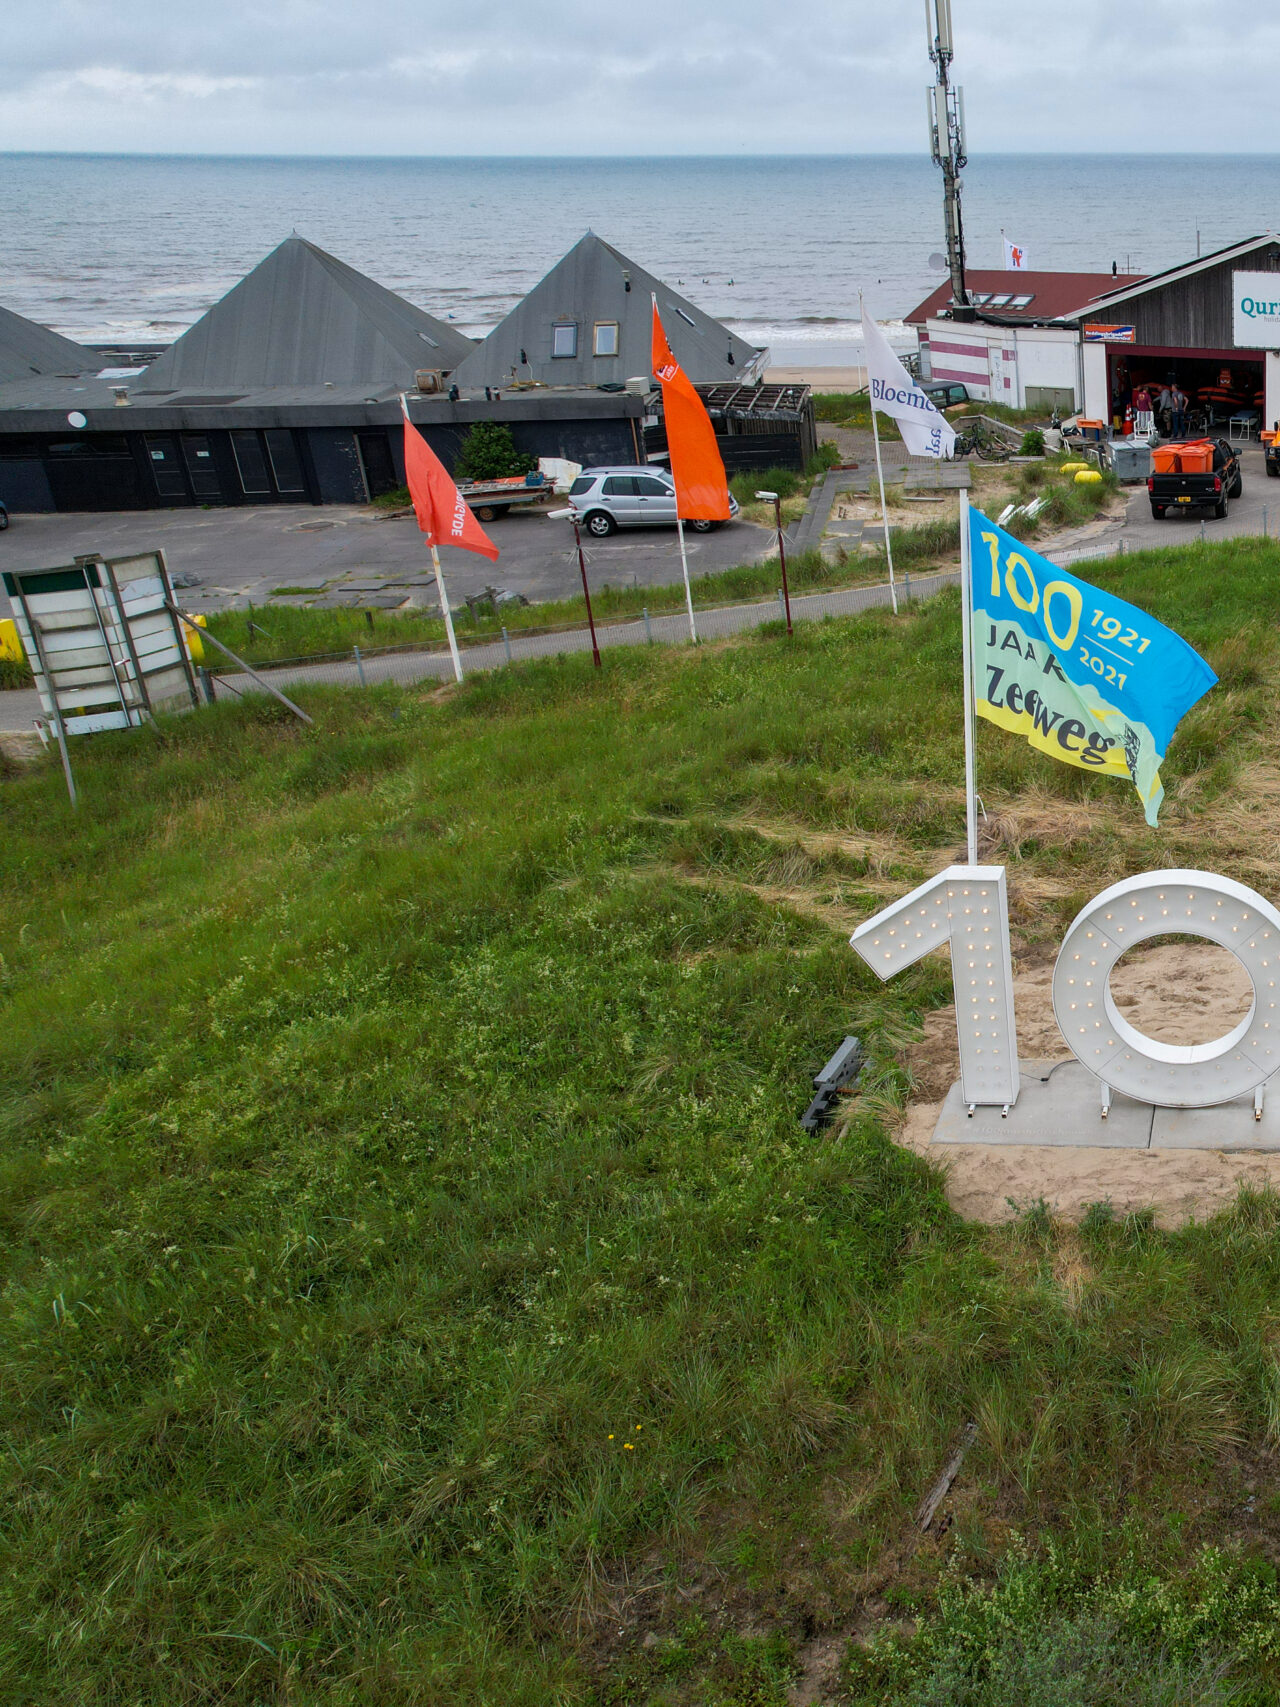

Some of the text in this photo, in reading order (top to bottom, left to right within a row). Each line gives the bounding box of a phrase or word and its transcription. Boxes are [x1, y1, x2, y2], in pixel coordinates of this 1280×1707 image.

[981, 531, 1083, 651] 100
[1091, 609, 1151, 654] 1921
[1080, 647, 1128, 691] 2021
[986, 664, 1116, 766] Zeeweg
